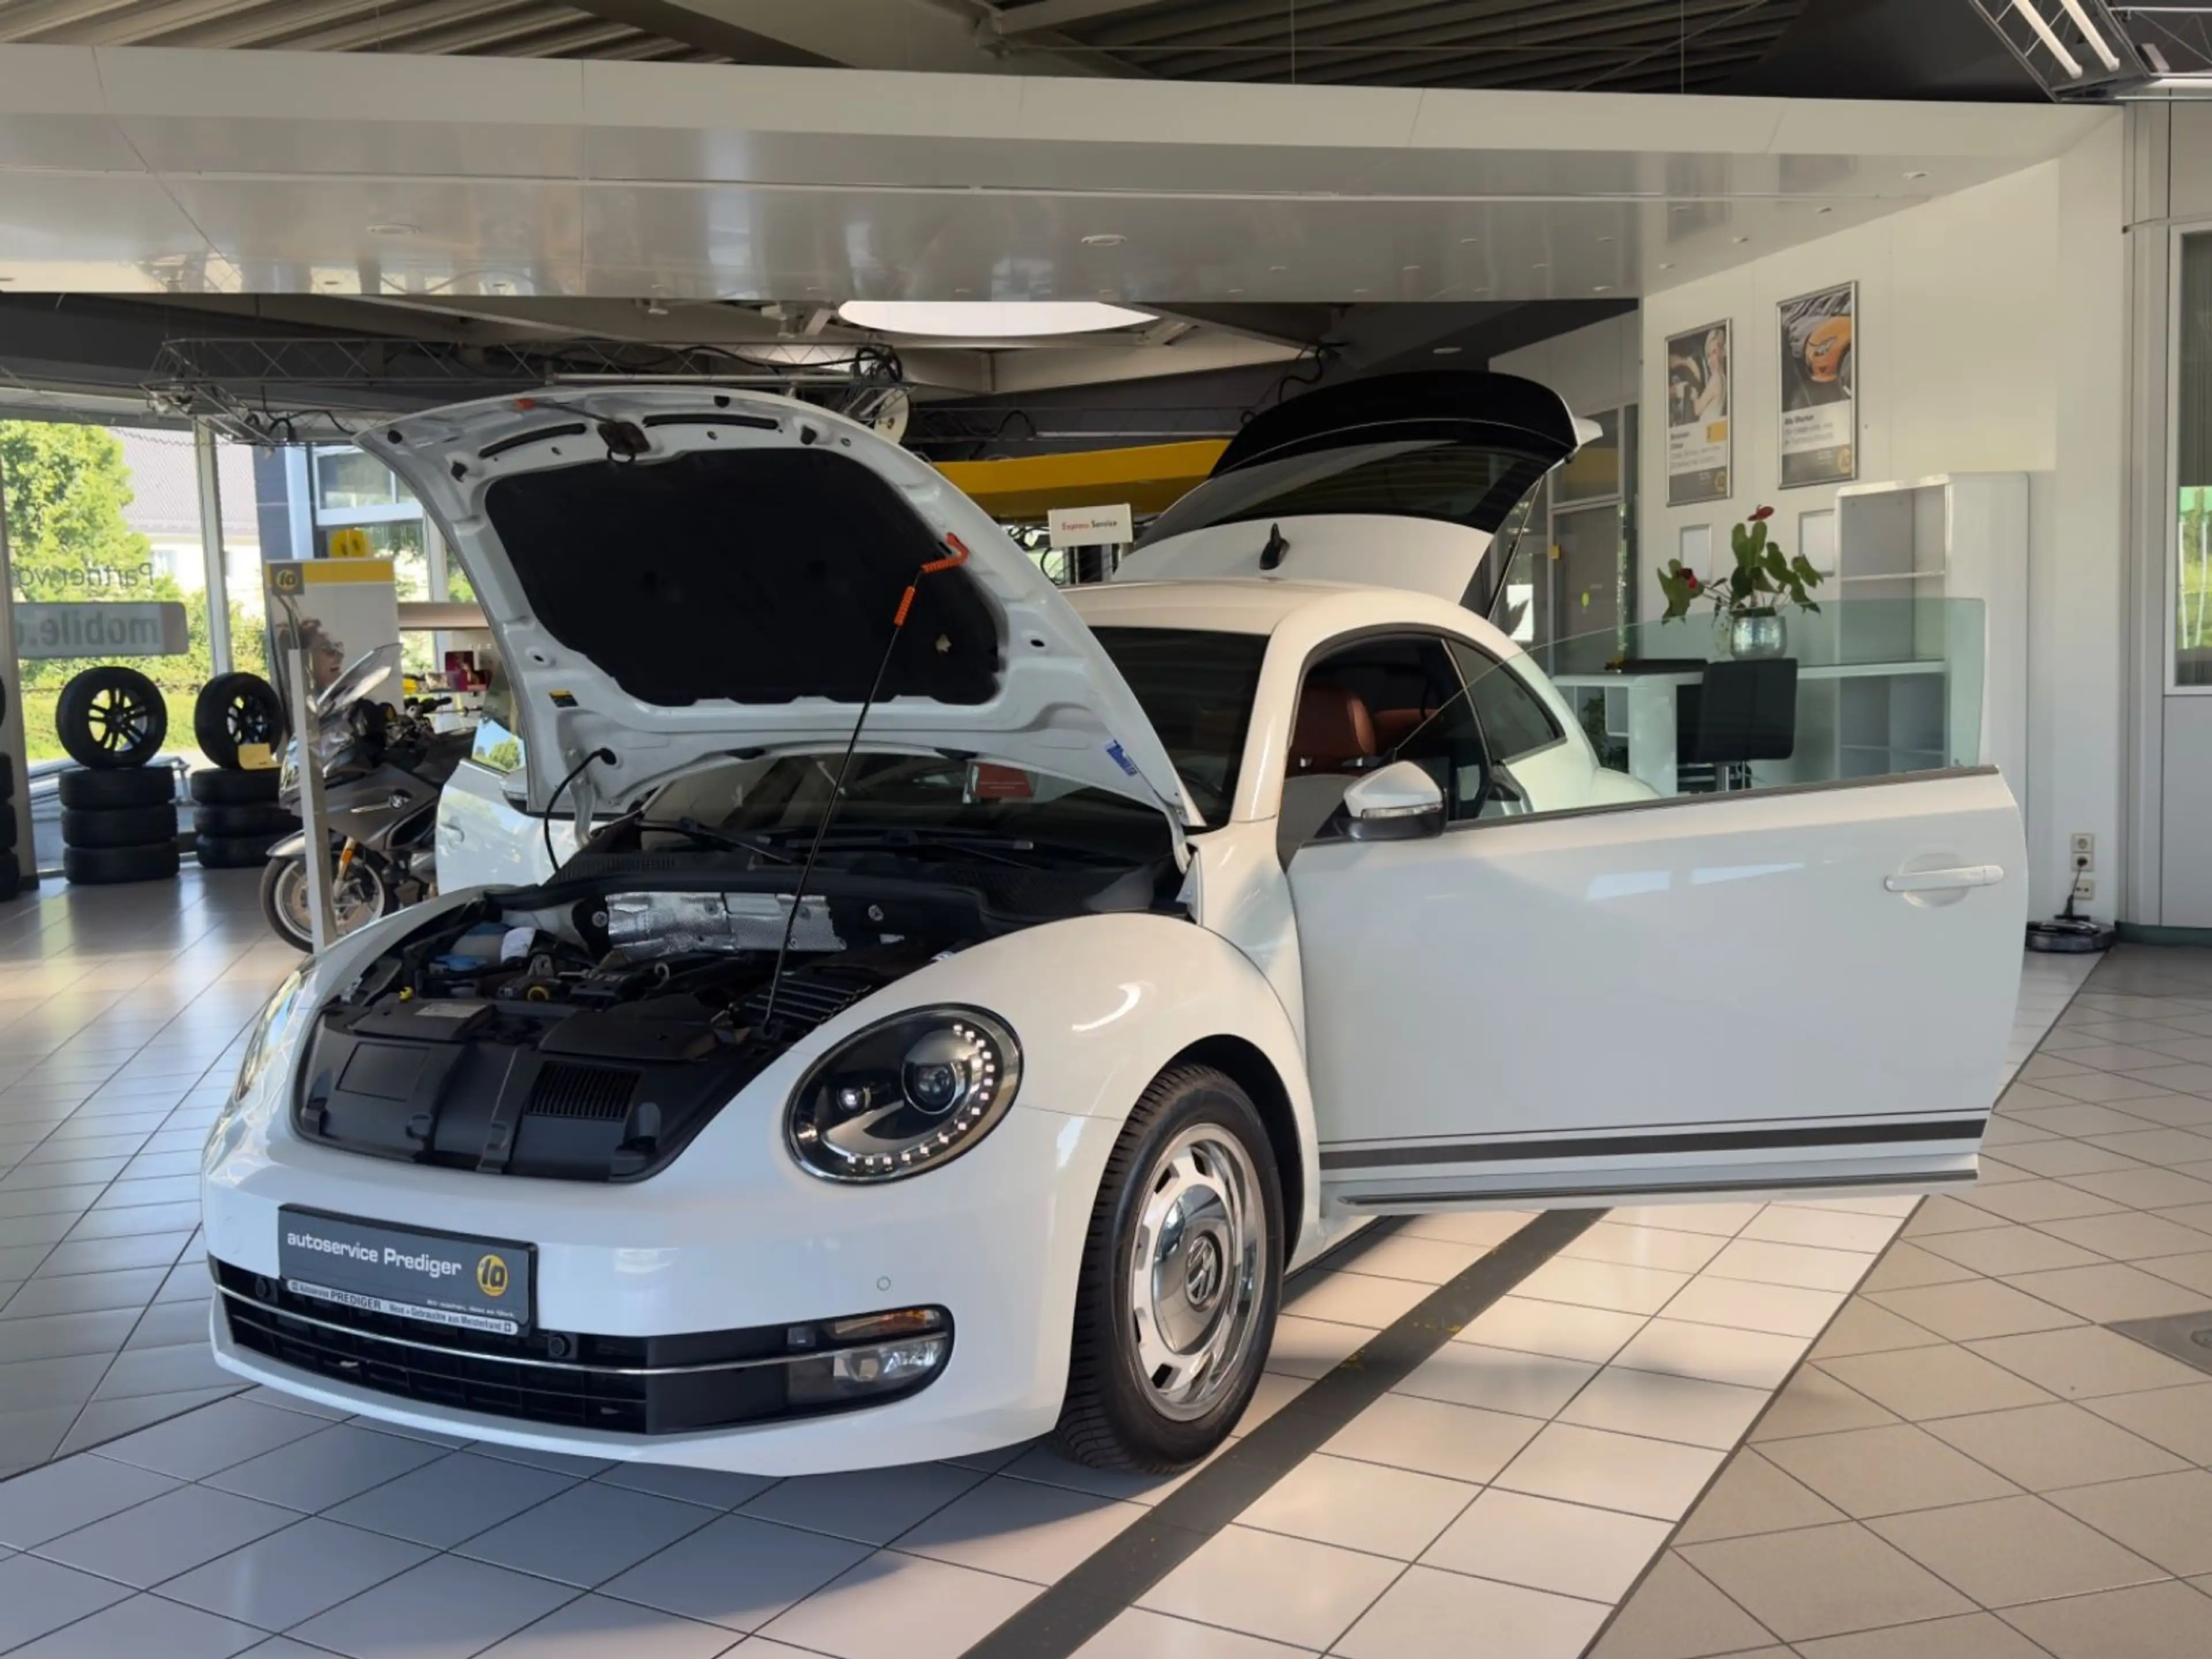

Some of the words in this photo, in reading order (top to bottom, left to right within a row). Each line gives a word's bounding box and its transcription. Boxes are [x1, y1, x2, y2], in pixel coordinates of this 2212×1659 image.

[1091, 520, 1118, 528] Service
[287, 1233, 378, 1263] autoservice
[384, 1248, 461, 1278] Prediger
[330, 1291, 381, 1310] PREDIGER
